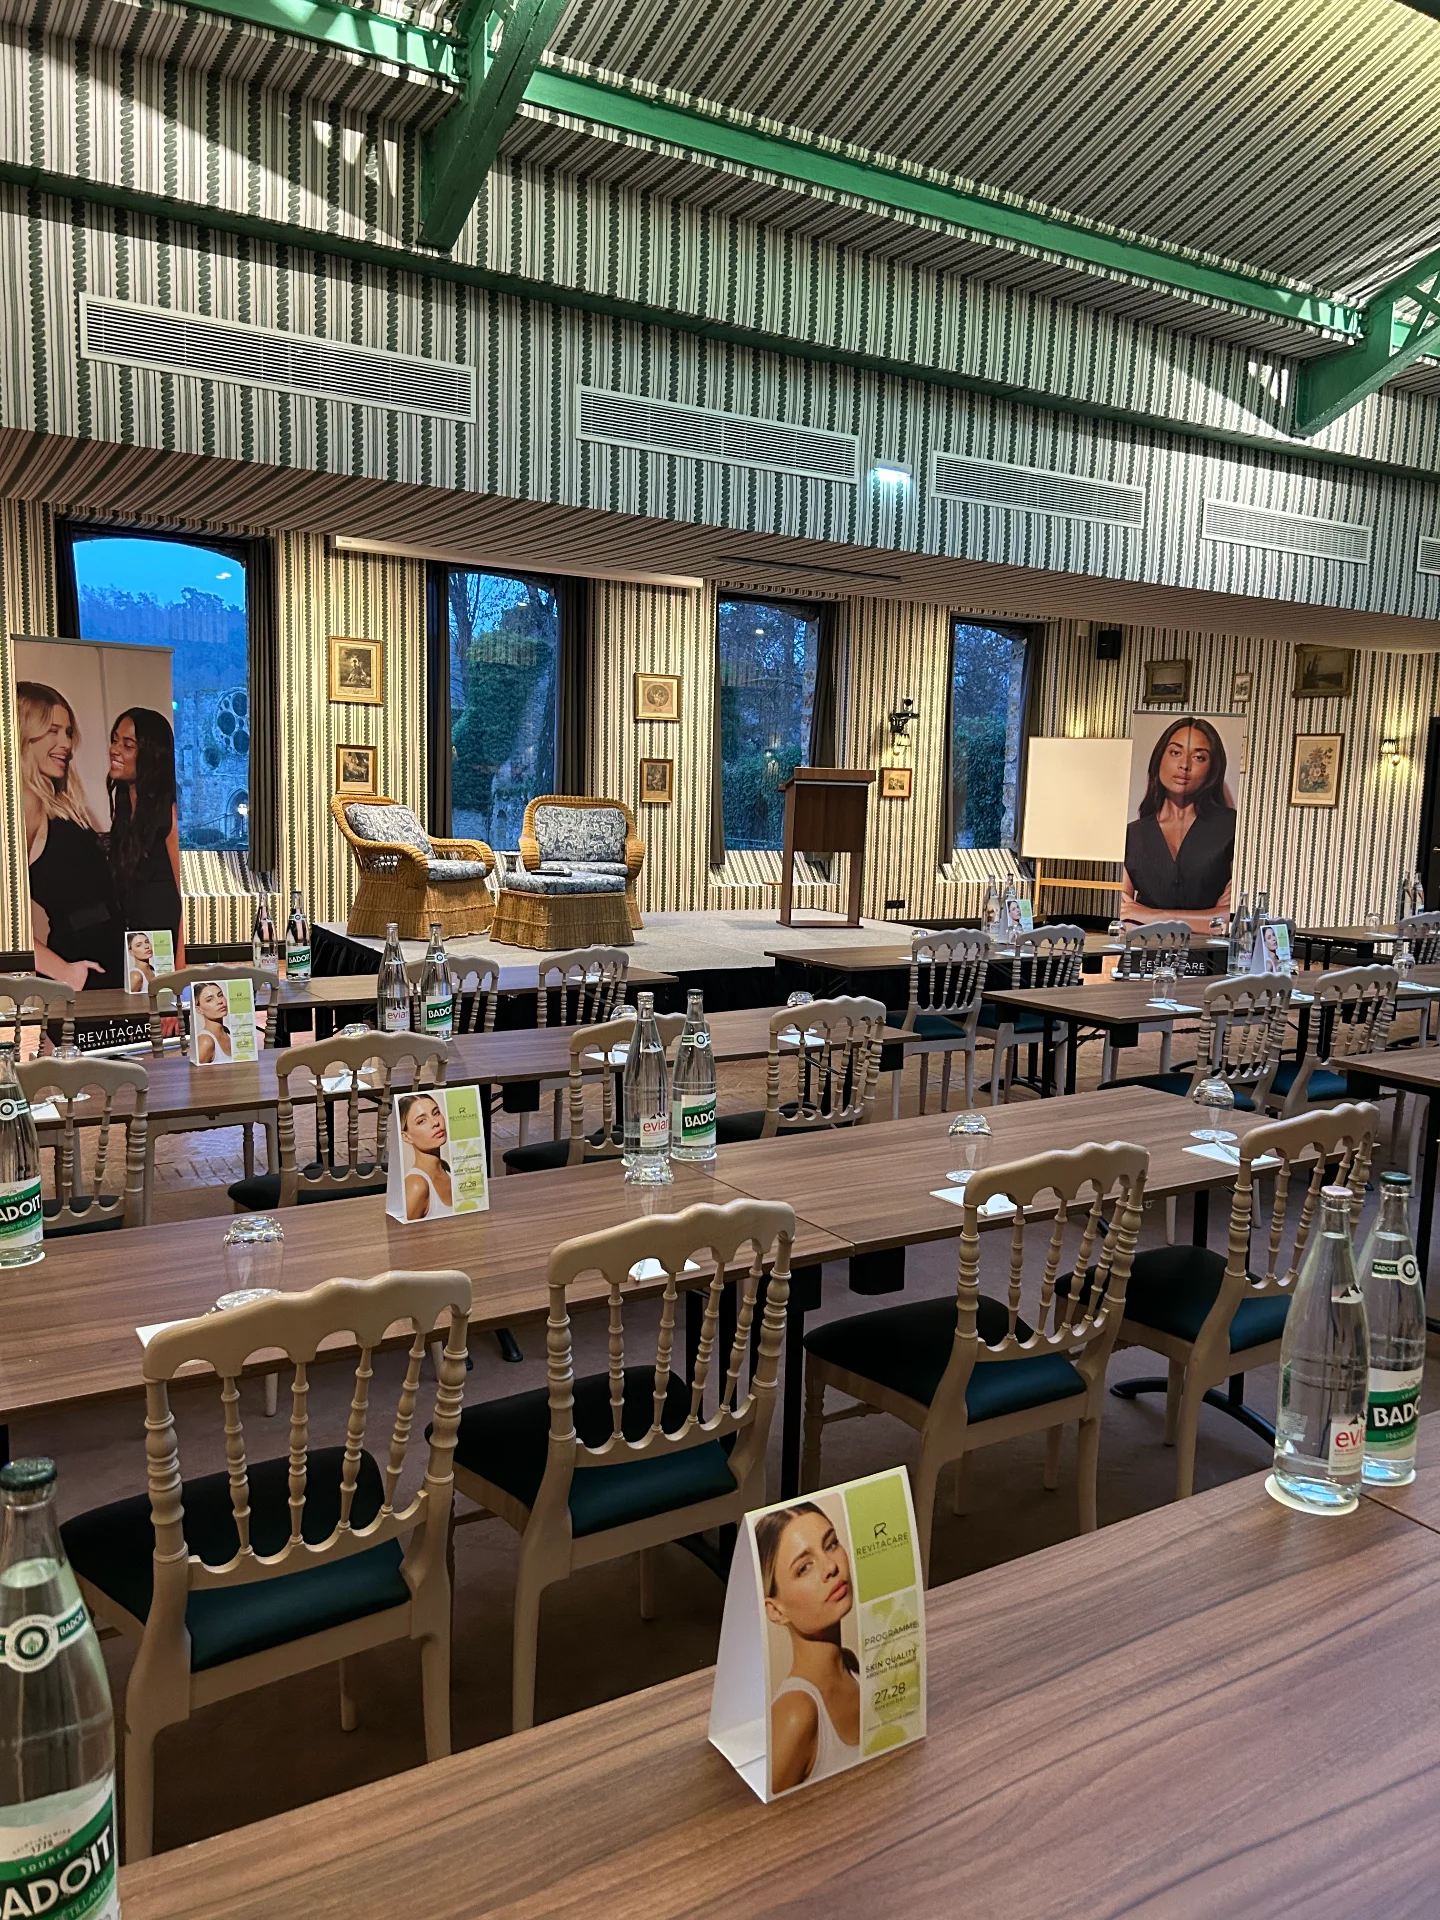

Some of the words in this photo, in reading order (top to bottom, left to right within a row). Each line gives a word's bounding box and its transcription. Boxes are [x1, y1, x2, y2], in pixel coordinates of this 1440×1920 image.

[428, 1005, 452, 1018] BADO
[78, 1023, 151, 1043] REVITACAR
[685, 1108, 716, 1128] BADO
[0, 1194, 40, 1221] ADOIT
[1373, 1395, 1421, 1427] BADO
[1335, 1426, 1365, 1448] evi
[856, 1532, 908, 1556] REVITACARE
[865, 1620, 919, 1646] PROGRAMME
[865, 1660, 883, 1673] SKIN
[885, 1646, 917, 1666] QUALITY
[0, 1825, 109, 1920] ADOIT
[20, 1847, 72, 1875] SOURCE
